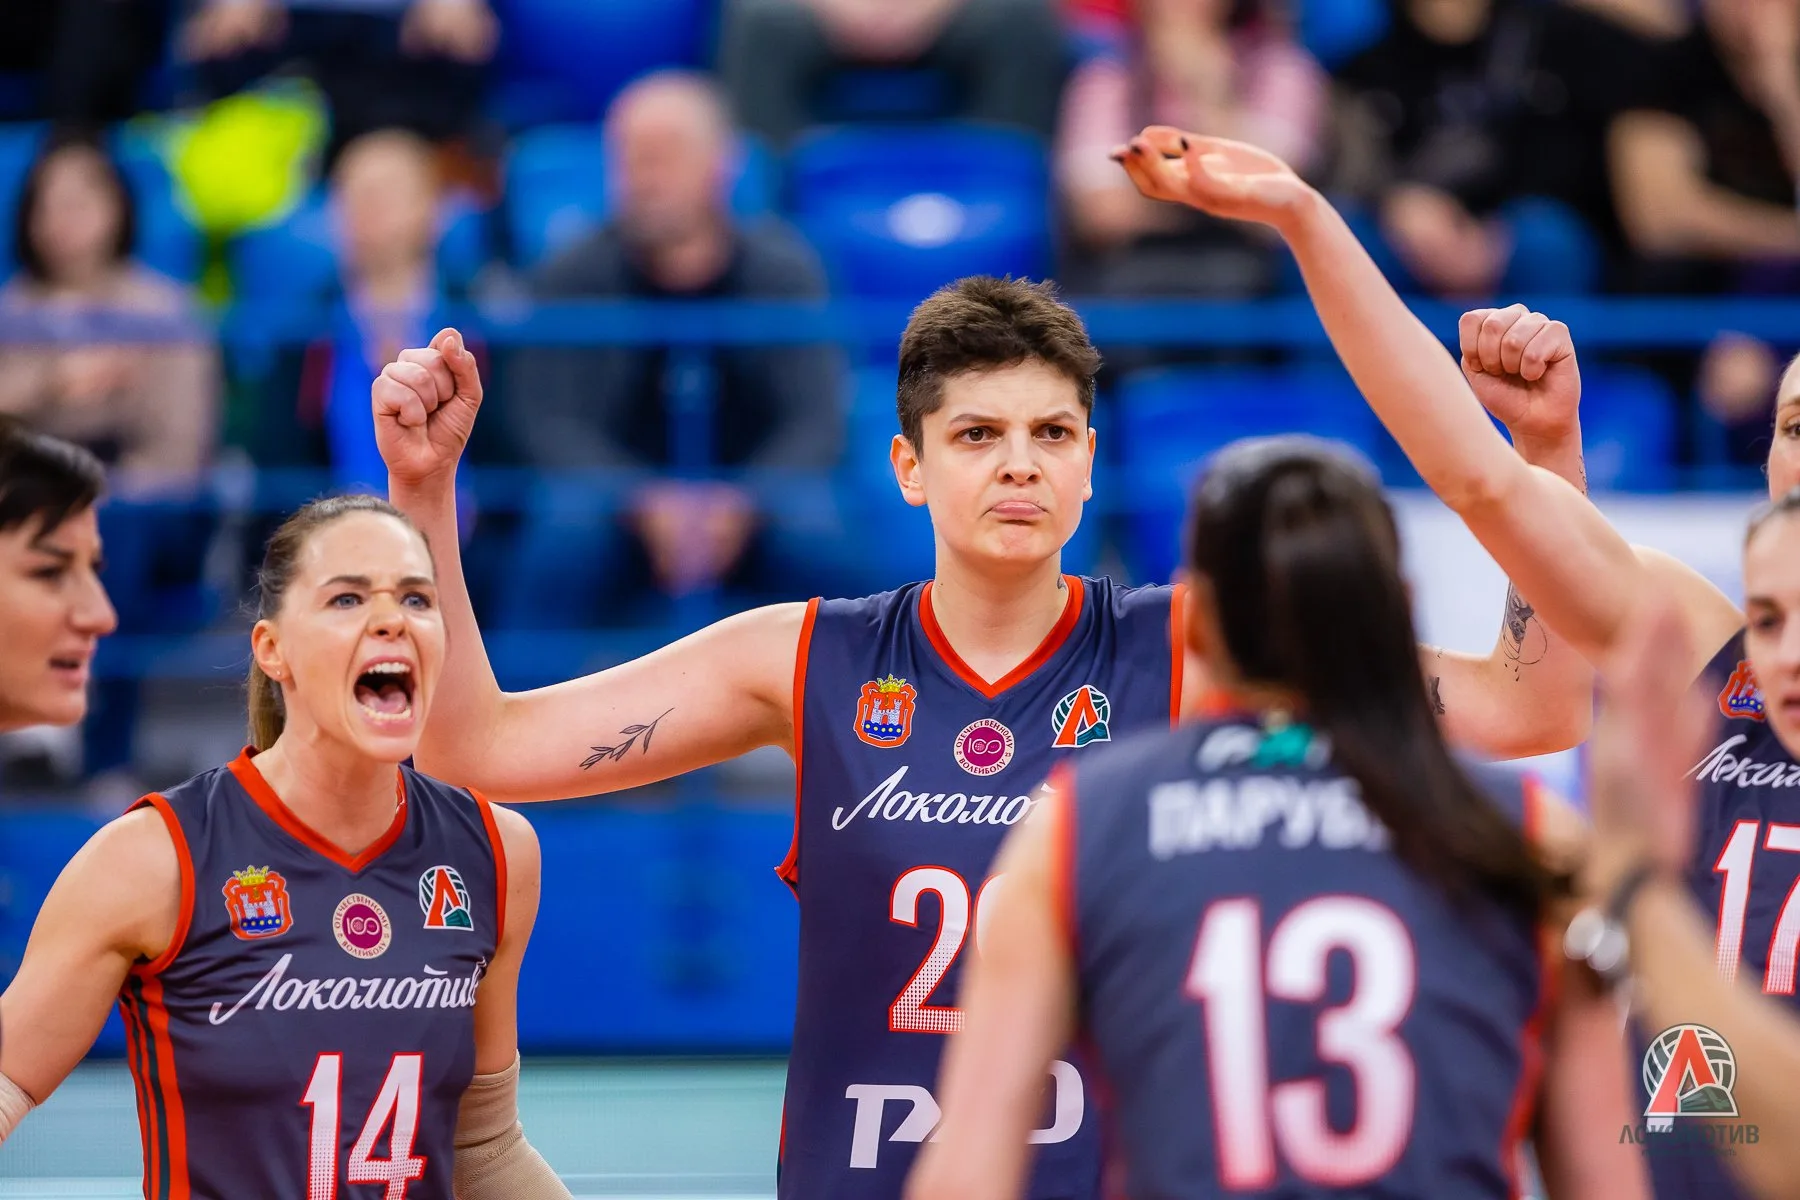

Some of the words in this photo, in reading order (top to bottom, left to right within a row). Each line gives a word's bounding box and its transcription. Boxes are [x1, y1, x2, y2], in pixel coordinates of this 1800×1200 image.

[1712, 819, 1800, 996] 17
[298, 1051, 428, 1200] 14
[1183, 893, 1417, 1191] 13
